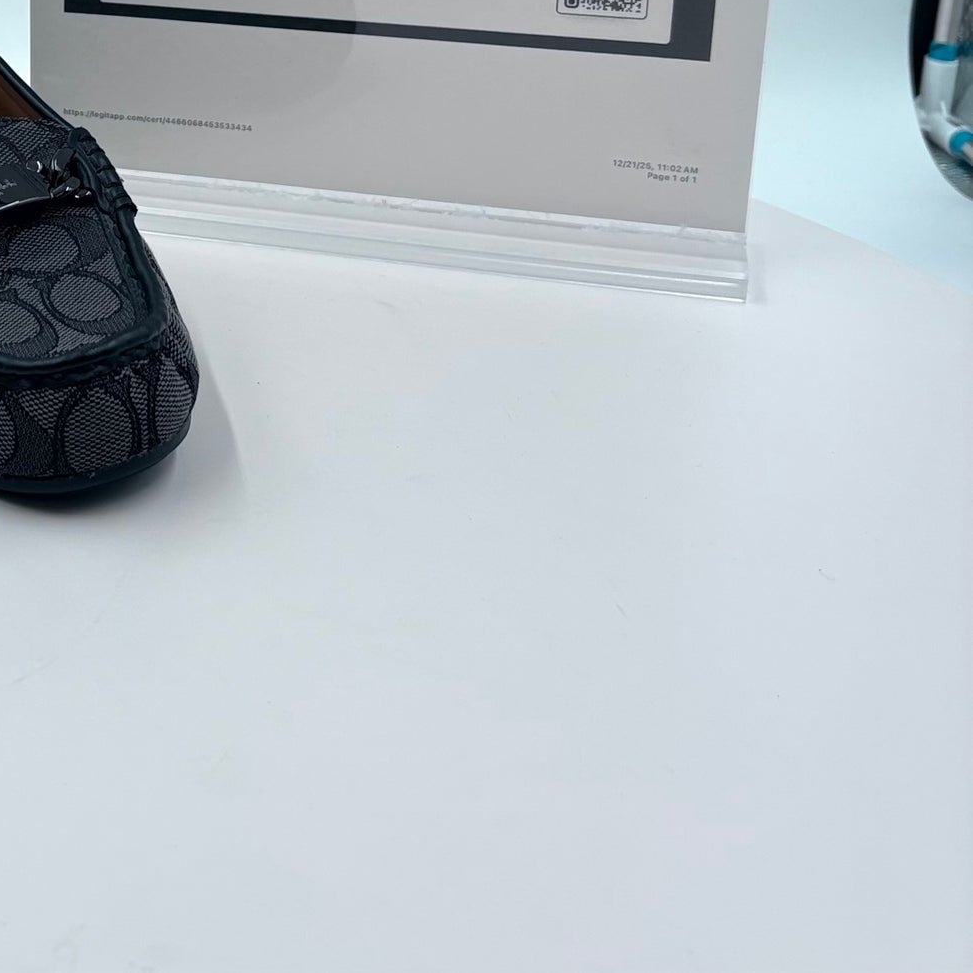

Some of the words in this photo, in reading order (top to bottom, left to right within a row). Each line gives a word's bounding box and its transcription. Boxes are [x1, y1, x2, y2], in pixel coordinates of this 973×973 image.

[613, 159, 654, 171] 12/21/25,
[657, 163, 682, 173] 11:02
[683, 166, 699, 174] AM
[647, 171, 670, 182] Page
[672, 174, 677, 182] 1
[680, 175, 689, 183] of
